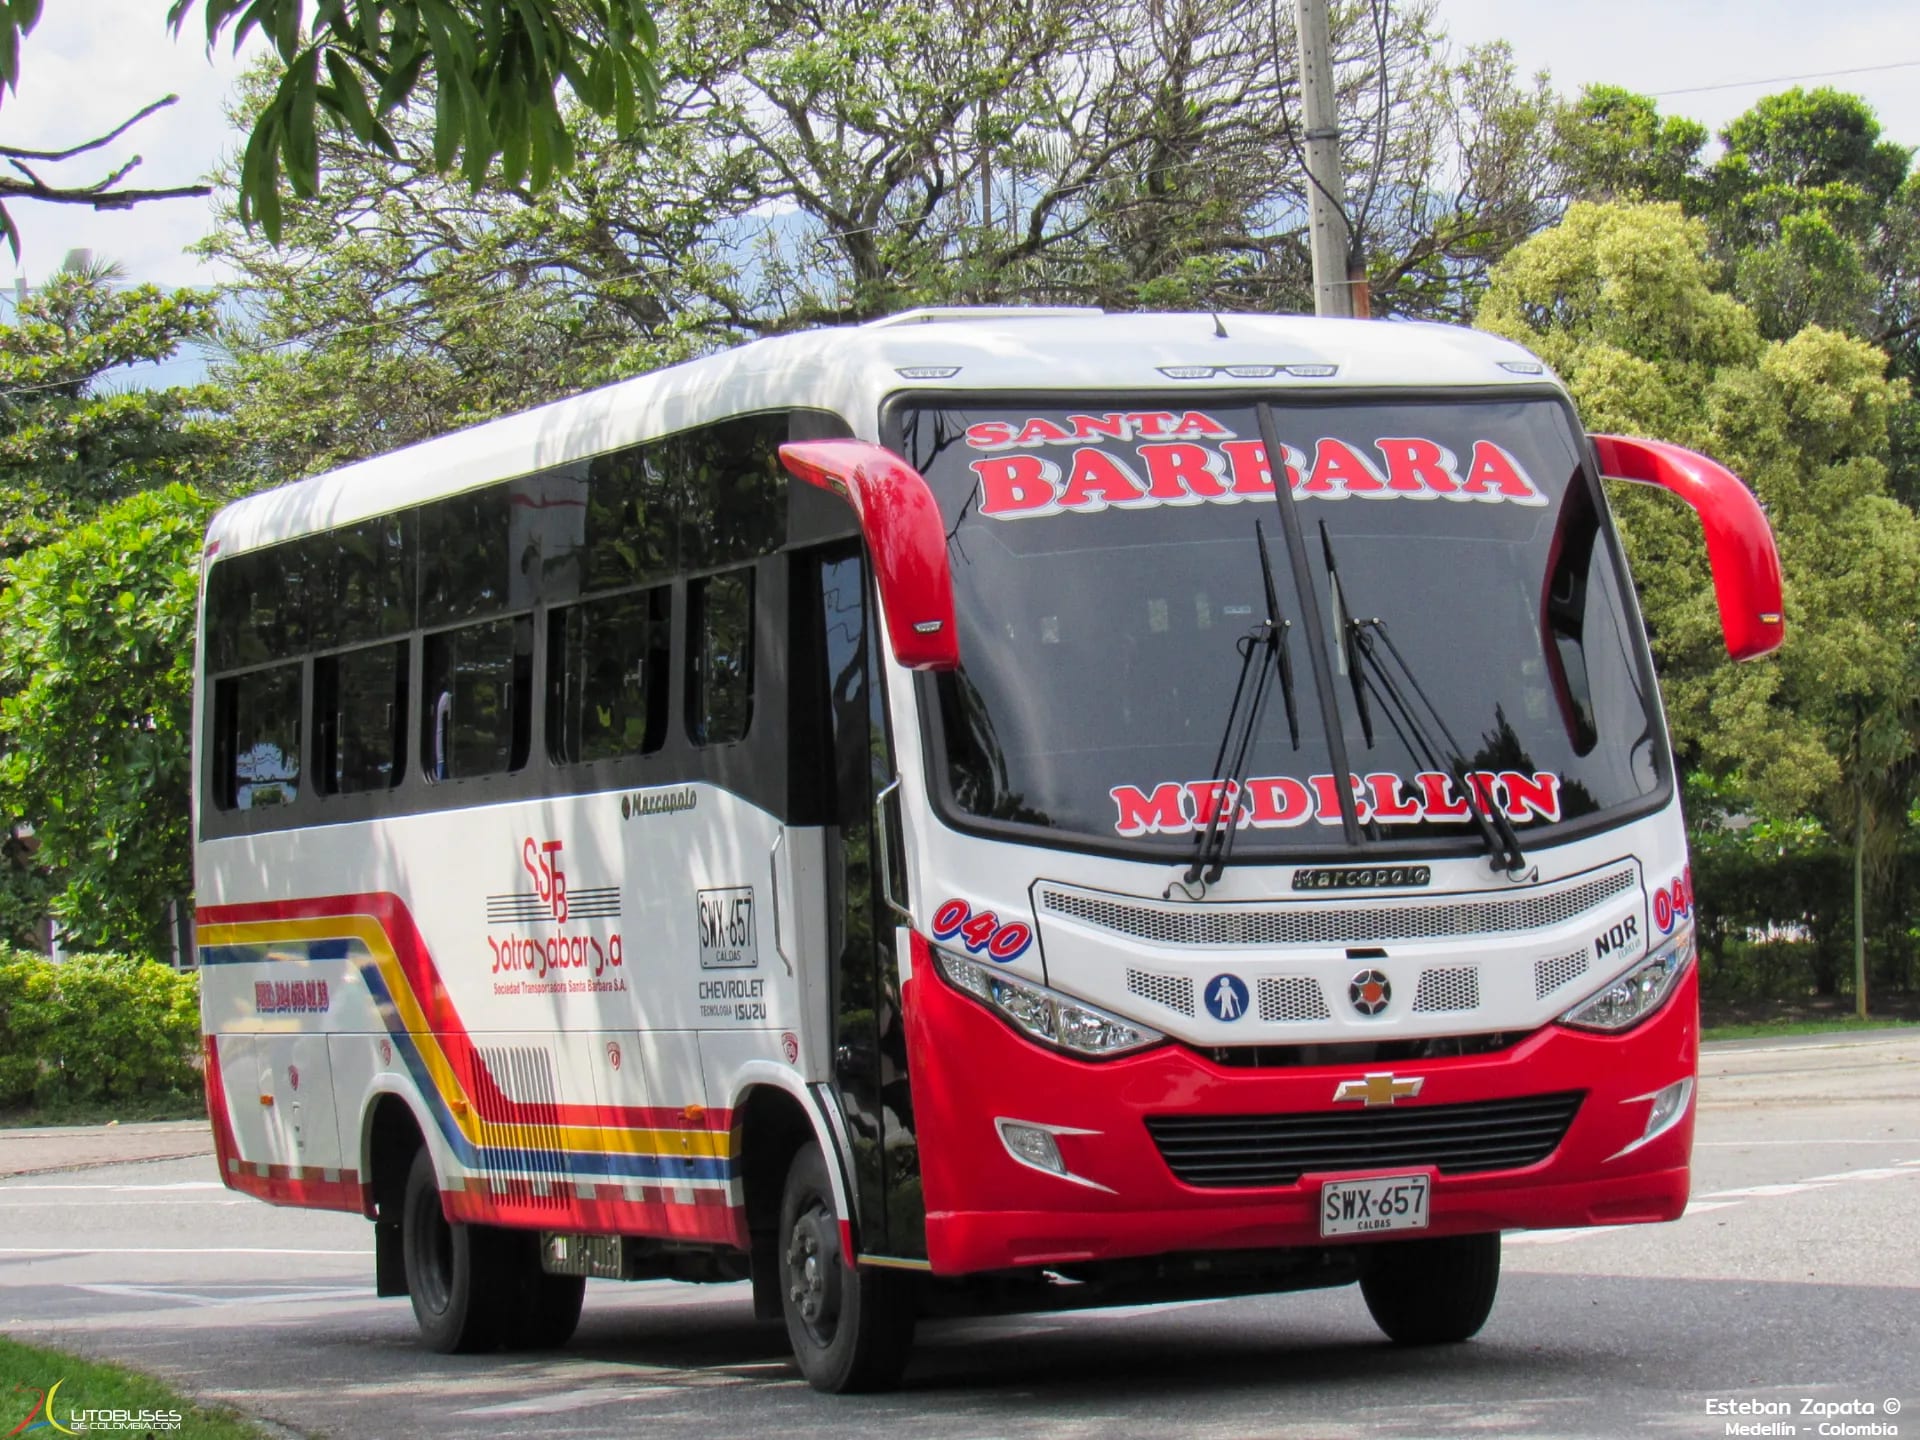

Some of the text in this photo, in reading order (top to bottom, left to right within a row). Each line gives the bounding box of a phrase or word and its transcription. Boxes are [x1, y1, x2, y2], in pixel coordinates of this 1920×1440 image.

[965, 411, 1236, 451] SANTA
[970, 438, 1548, 520] BARBARA
[632, 787, 697, 816] Marcopolo
[1111, 772, 1561, 837] MEDELLIN
[1294, 866, 1428, 888] Marcopolo
[932, 898, 1033, 963] 040
[716, 950, 741, 961] CALDAS
[494, 982, 520, 995] Sociedad
[522, 981, 567, 997] Transportadora
[569, 980, 587, 993] Santa
[699, 979, 764, 999] CHEVROLET
[735, 1002, 767, 1021] ISUZU
[1357, 1219, 1391, 1230] CALDAS
